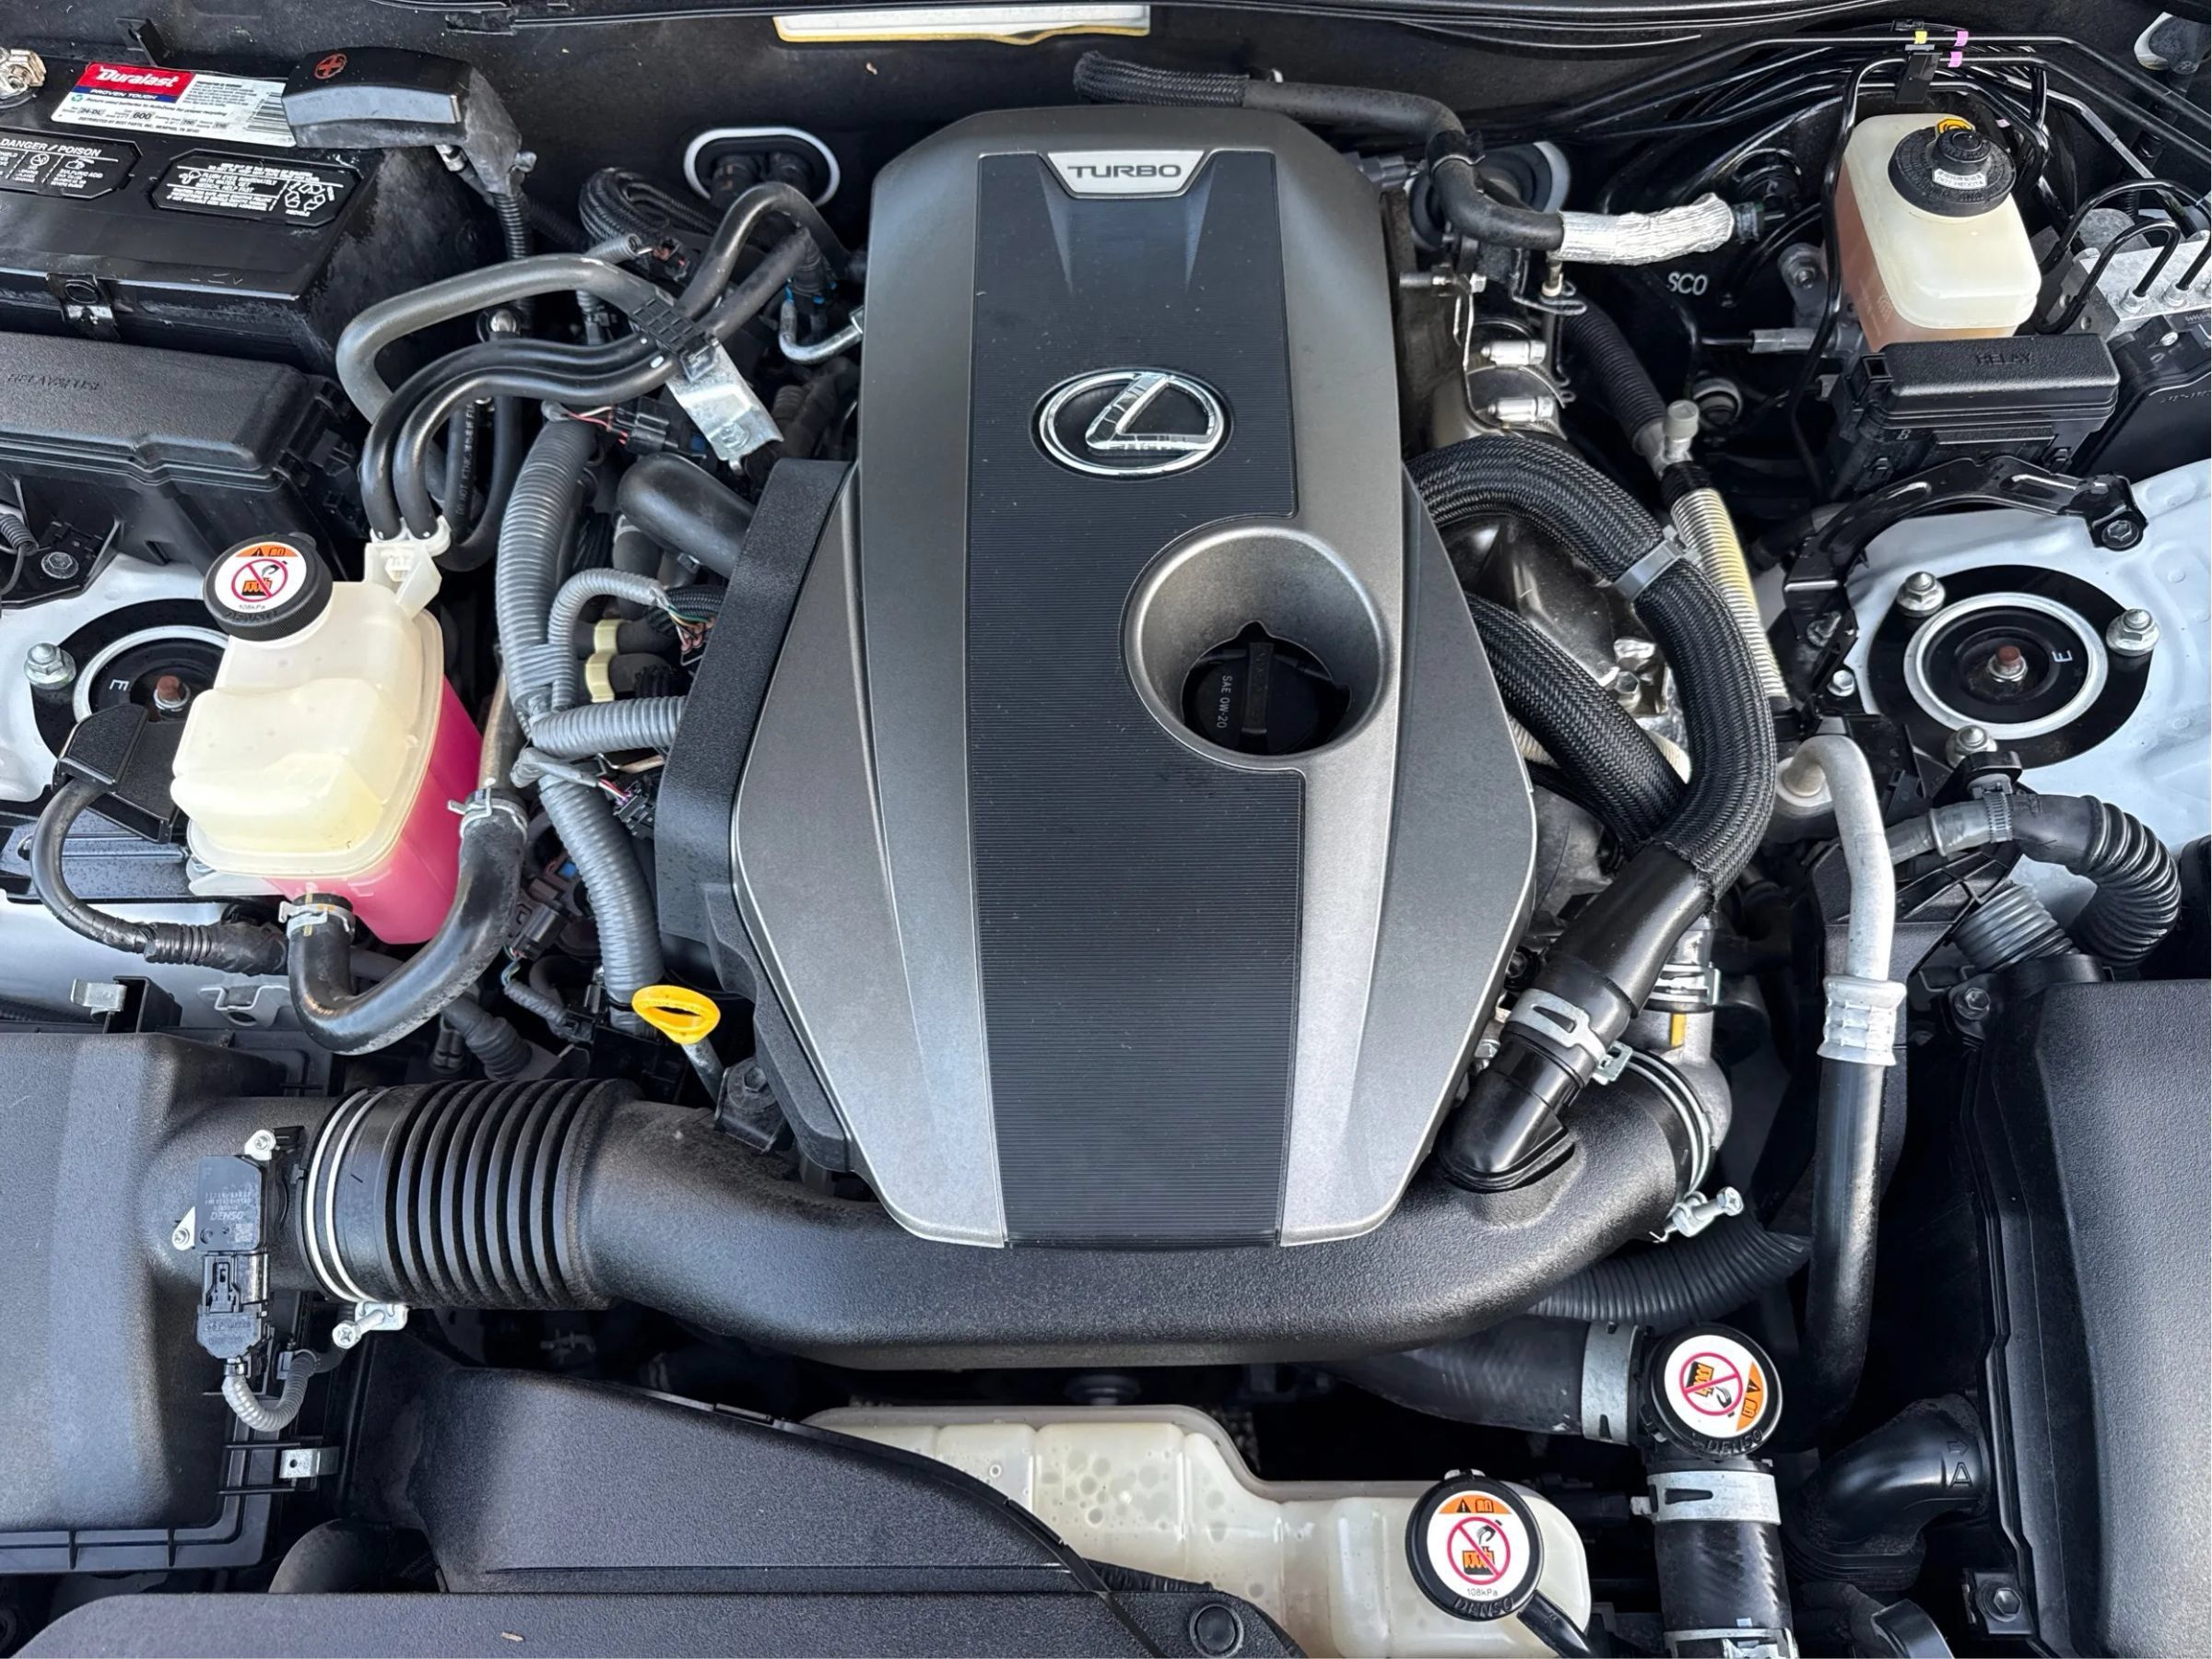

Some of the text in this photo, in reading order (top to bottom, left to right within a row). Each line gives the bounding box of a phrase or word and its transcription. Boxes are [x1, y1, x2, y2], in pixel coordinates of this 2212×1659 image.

[96, 65, 180, 88] Duralast
[90, 88, 125, 97] PROVEN
[133, 112, 152, 120] 600
[0, 138, 48, 151] DANGER
[57, 145, 102, 157] POISON
[1067, 163, 1182, 178] TURBO
[1217, 675, 1233, 728] SAE 0W-20
[210, 1211, 244, 1221] DENSO
[1949, 1462, 1973, 1488] A
[1467, 1588, 1499, 1597] 108kPa
[1454, 1595, 1514, 1618] DENSO
